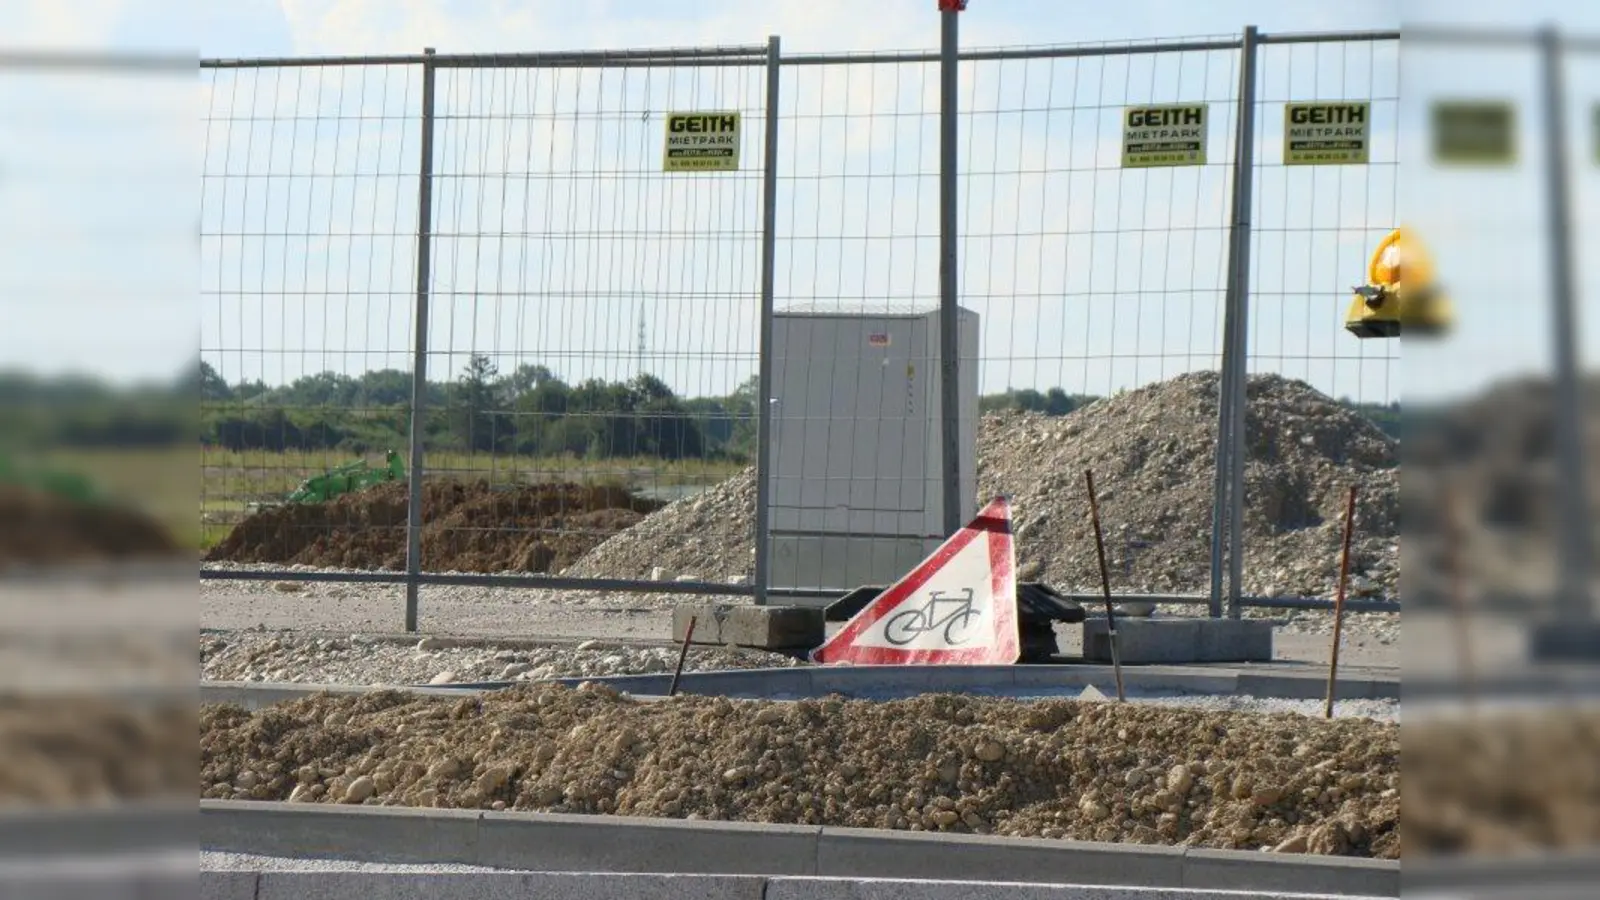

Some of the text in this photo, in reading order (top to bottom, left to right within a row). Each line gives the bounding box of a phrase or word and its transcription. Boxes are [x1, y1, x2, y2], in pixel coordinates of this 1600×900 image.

[1128, 108, 1201, 127] GEITH
[1291, 105, 1364, 124] GEITH
[670, 115, 735, 132] GEITH
[1127, 129, 1200, 139] MIETPARK
[1290, 127, 1362, 137] MIETPARK
[669, 135, 733, 145] MIETPARK
